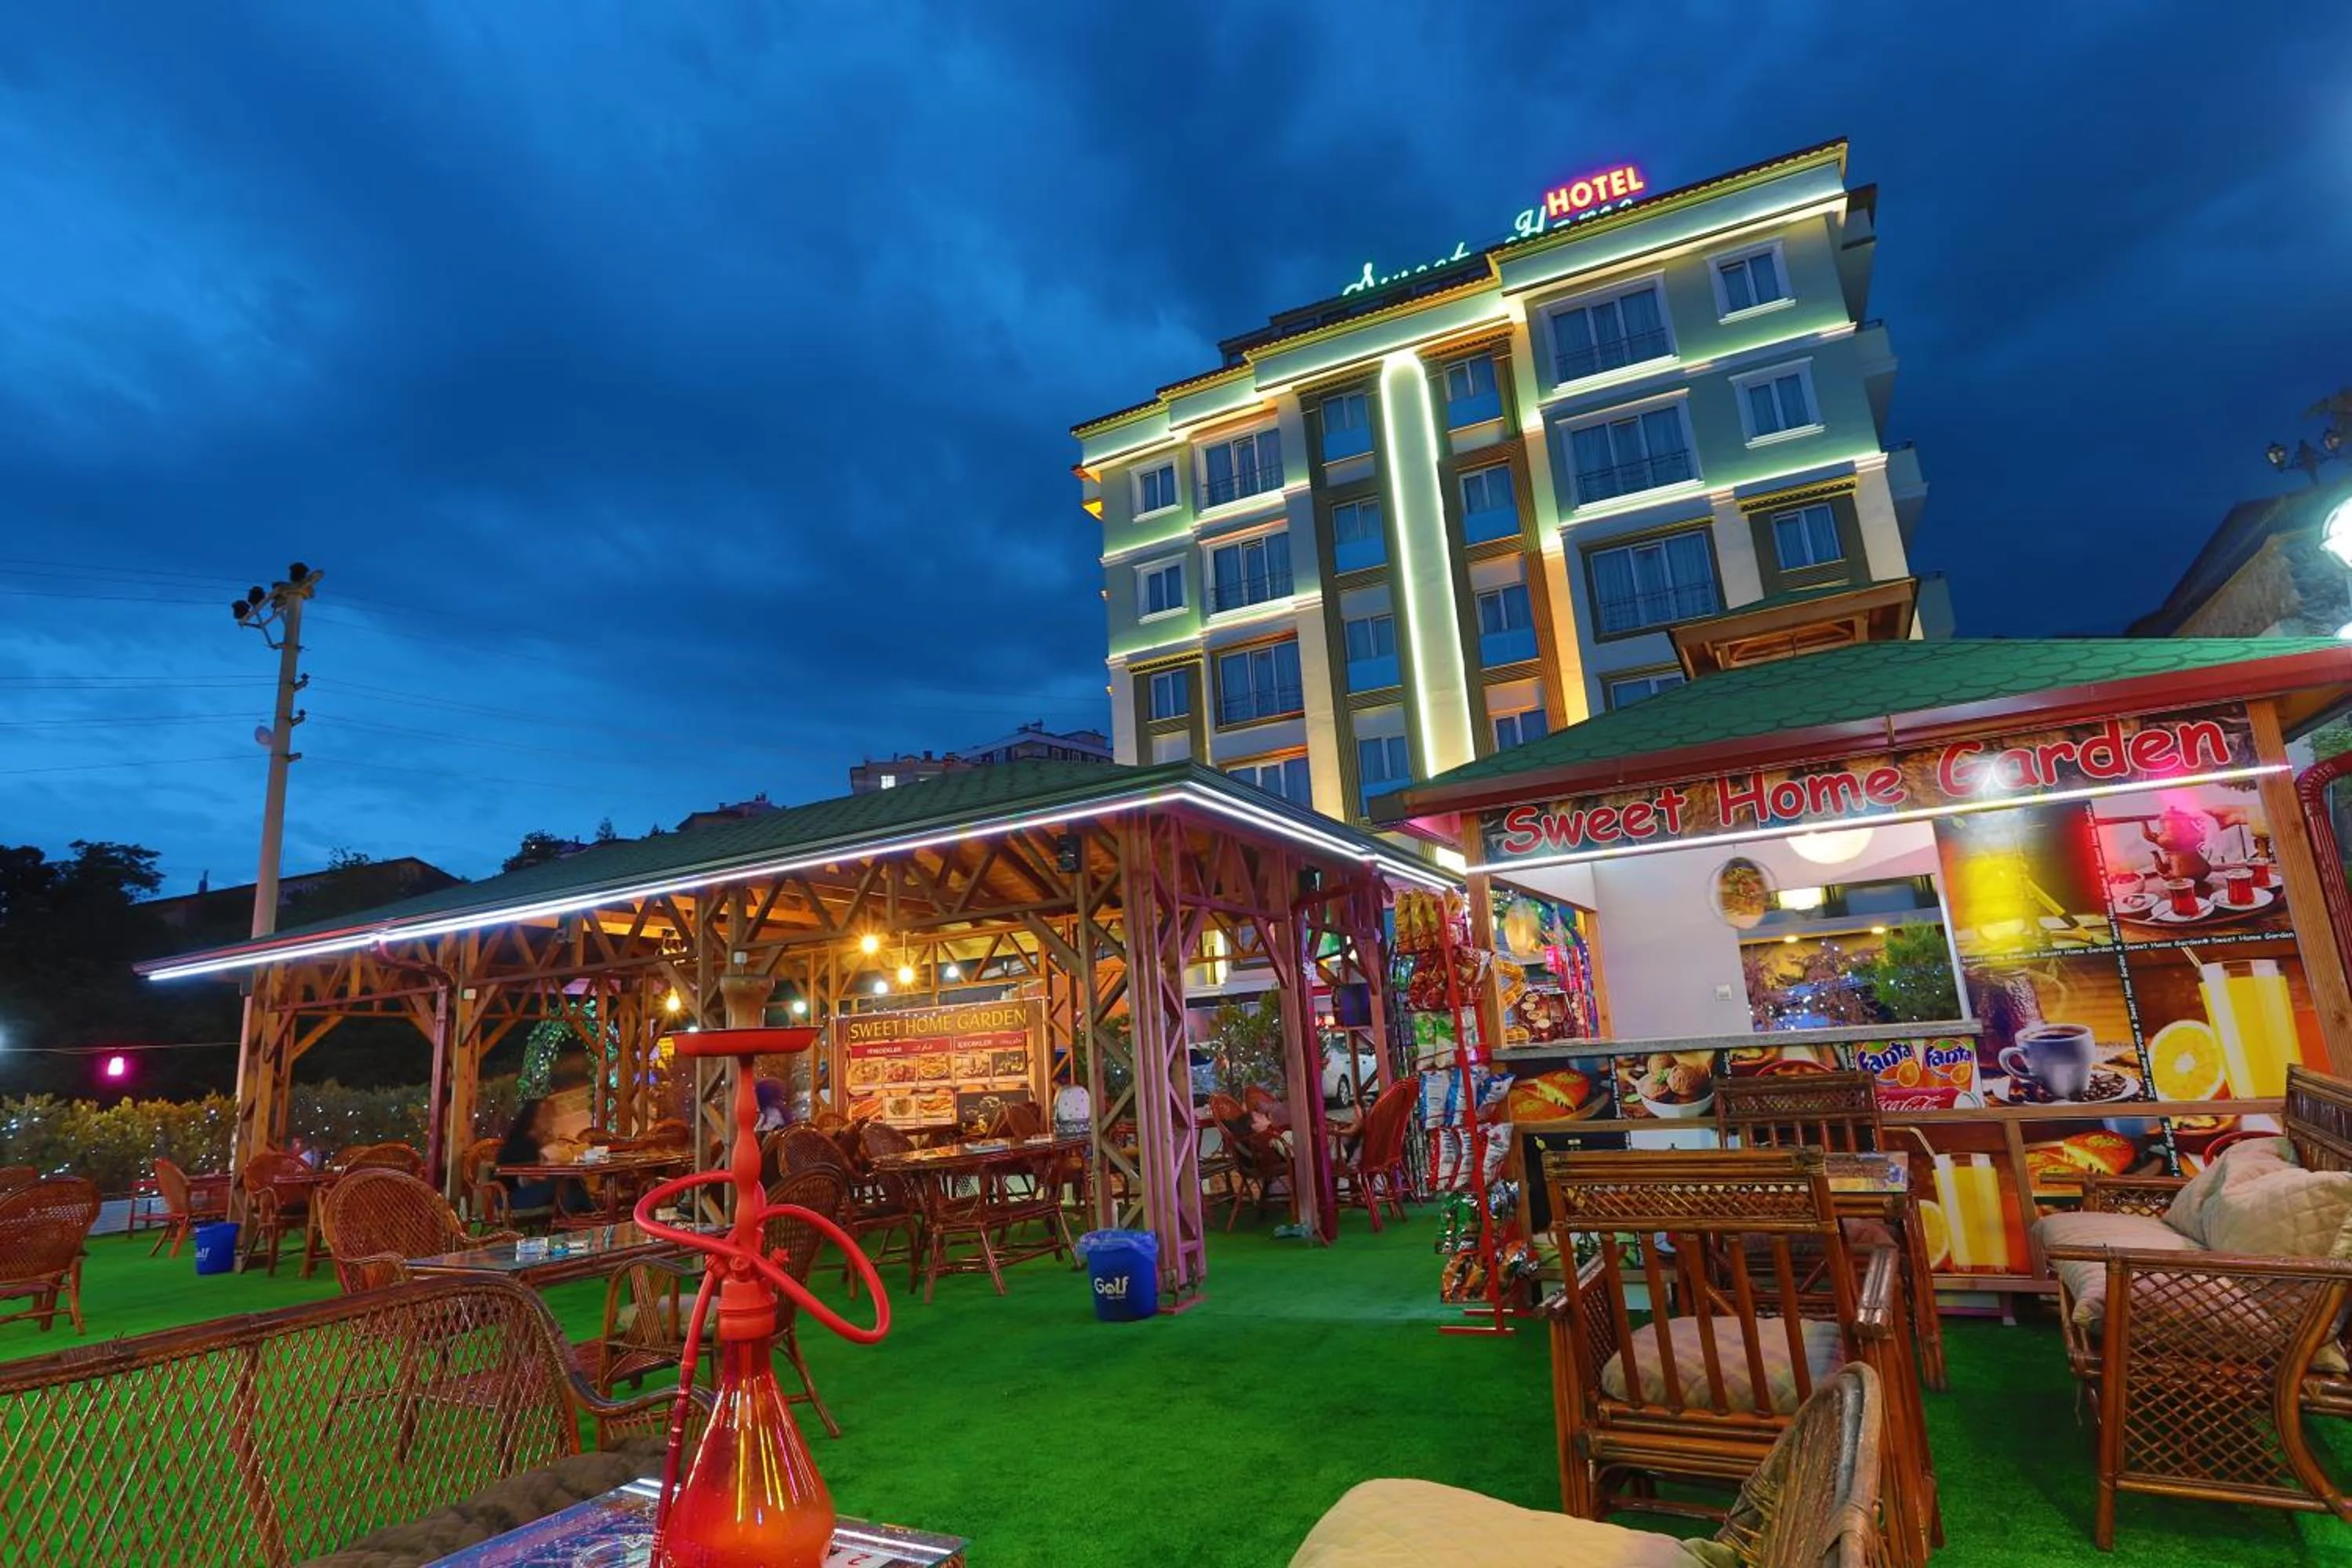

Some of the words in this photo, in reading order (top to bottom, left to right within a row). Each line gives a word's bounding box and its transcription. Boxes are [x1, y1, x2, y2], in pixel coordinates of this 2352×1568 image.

[1547, 166, 1645, 217] HOTEL
[1503, 787, 1687, 855] Sweet
[1715, 765, 1908, 829] Home
[1936, 719, 2232, 799] Garden
[849, 1019, 900, 1040] SWEET
[905, 1015, 953, 1036] HOME
[957, 1008, 1027, 1030] GARDEN
[1094, 1276, 1130, 1294] Golf
